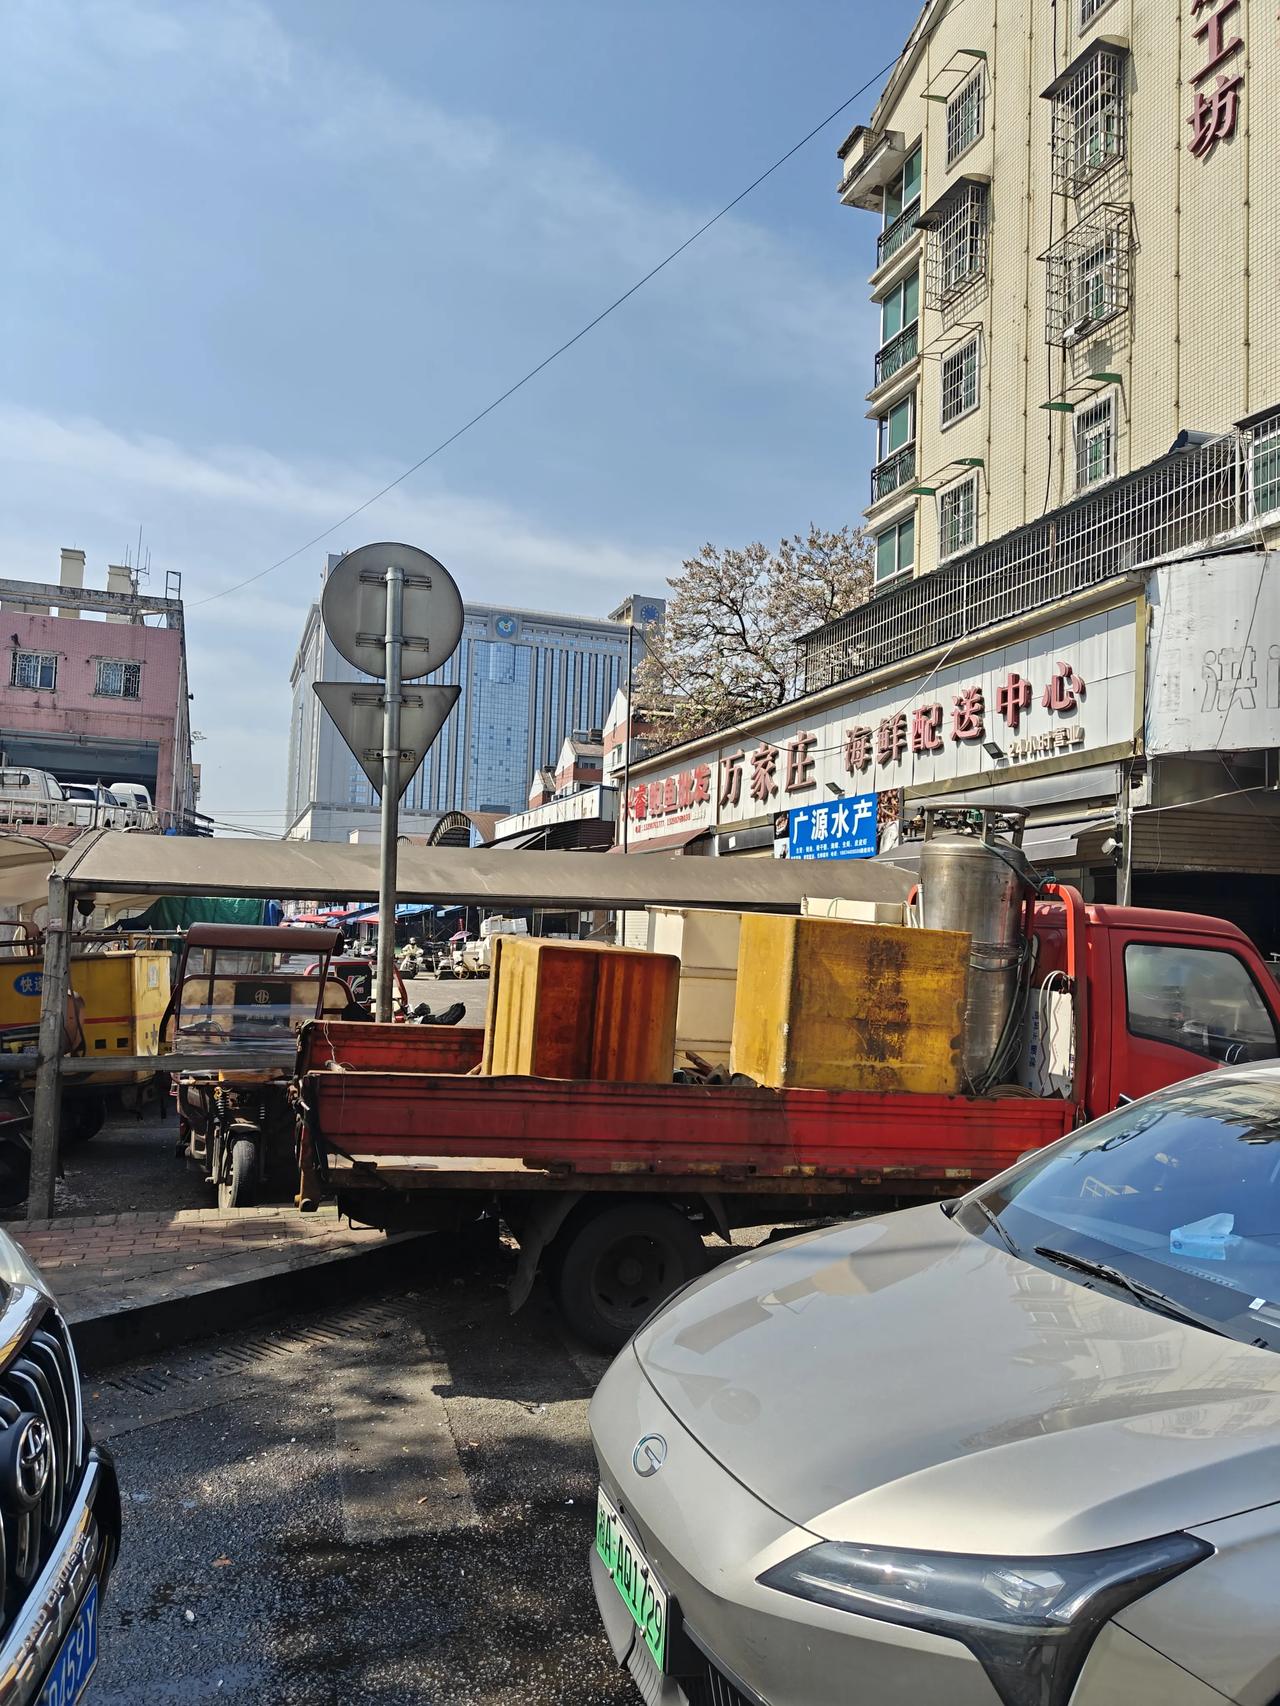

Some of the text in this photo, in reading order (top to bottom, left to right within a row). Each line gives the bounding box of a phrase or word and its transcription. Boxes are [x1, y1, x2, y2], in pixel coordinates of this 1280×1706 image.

[1186, 0, 1243, 158] 工坊
[1201, 645, 1280, 713] 洪
[720, 730, 817, 806] 万家庄
[843, 661, 1086, 771] 海鲜配送中心
[1007, 724, 1082, 758] 24小时营业
[793, 799, 873, 844] 广源水产
